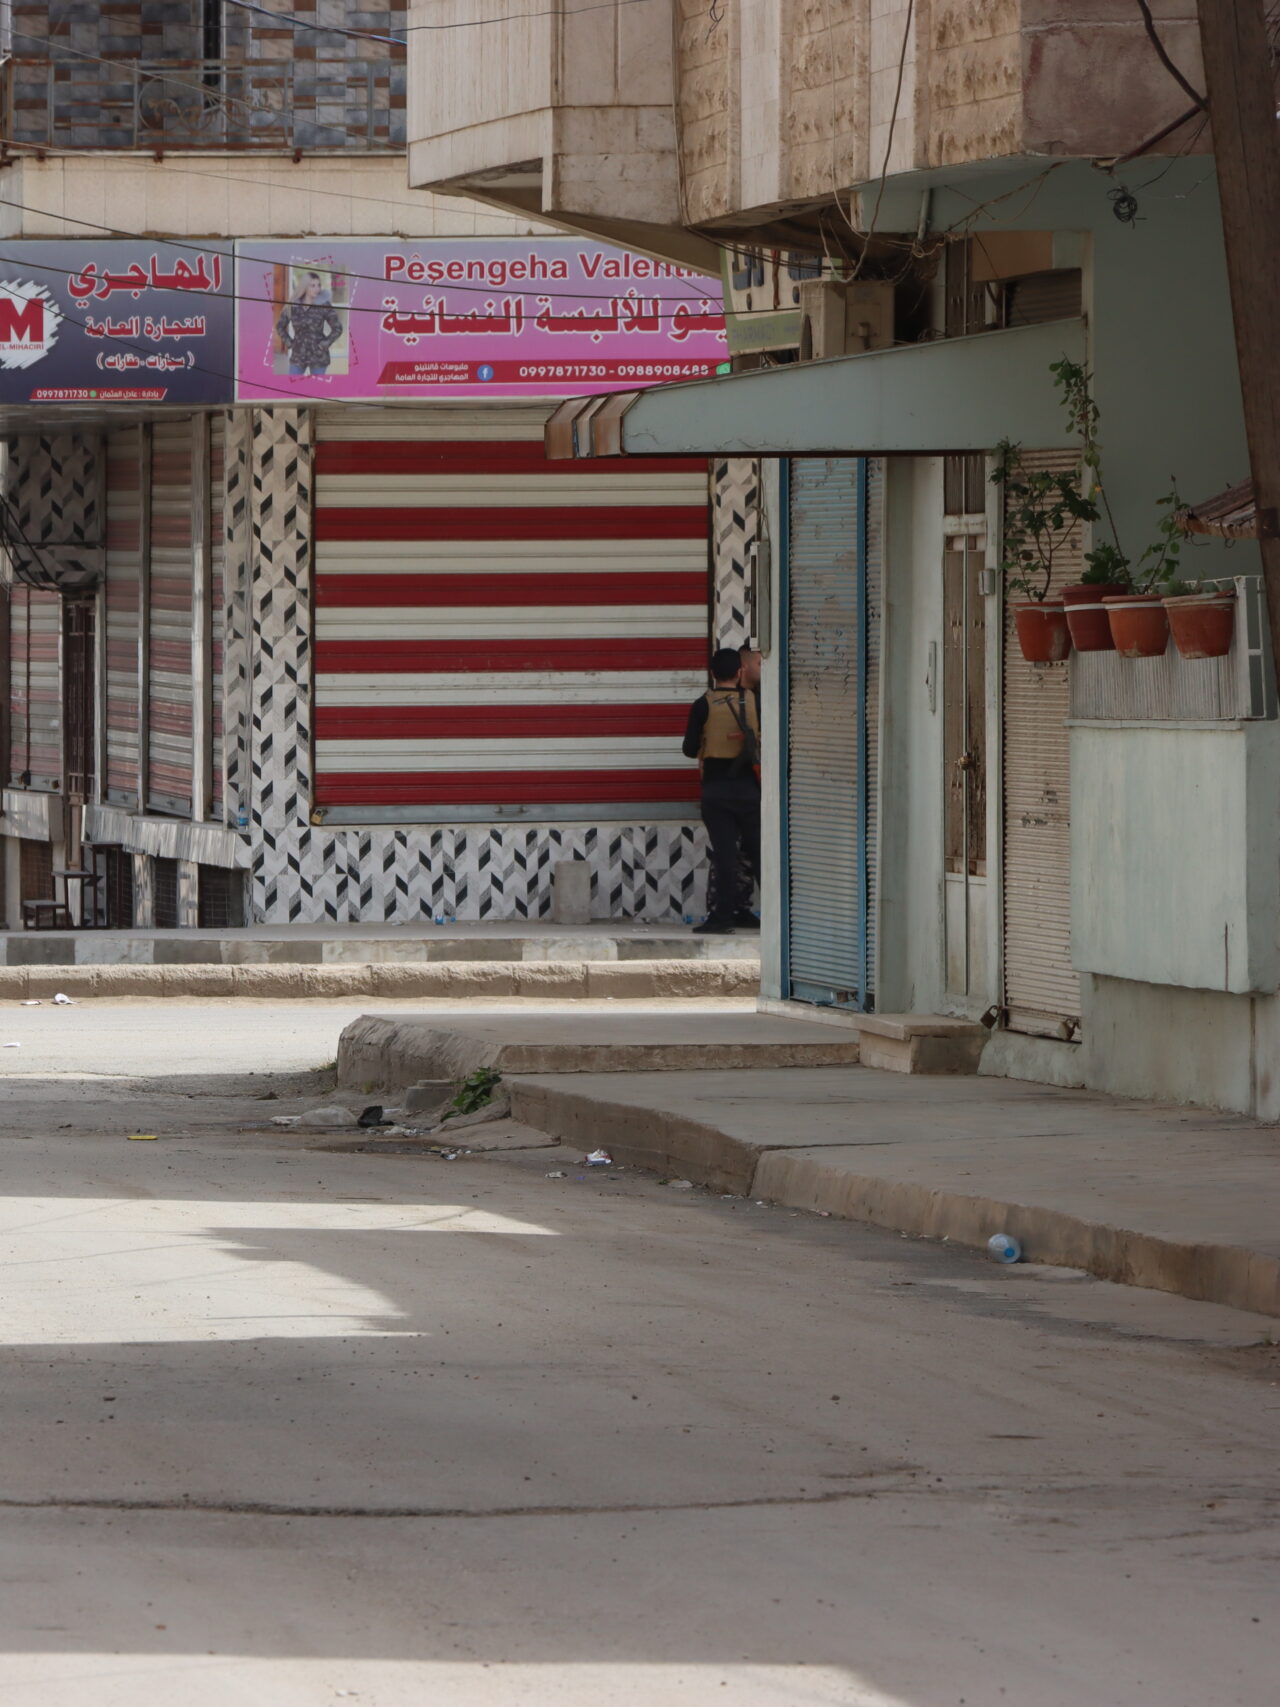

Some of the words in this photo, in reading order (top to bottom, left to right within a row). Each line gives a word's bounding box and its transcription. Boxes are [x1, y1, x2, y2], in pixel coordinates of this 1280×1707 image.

[68, 253, 222, 308] المهاجري
[383, 253, 570, 286] Pêşengeha
[85, 315, 140, 339] العامة
[144, 315, 205, 341] للتجارة
[381, 294, 524, 344] النسائية
[537, 288, 660, 342] للألبسة
[519, 366, 606, 377] 0997871730
[618, 365, 709, 376] 0988908488
[36, 389, 89, 399] 0997871730
